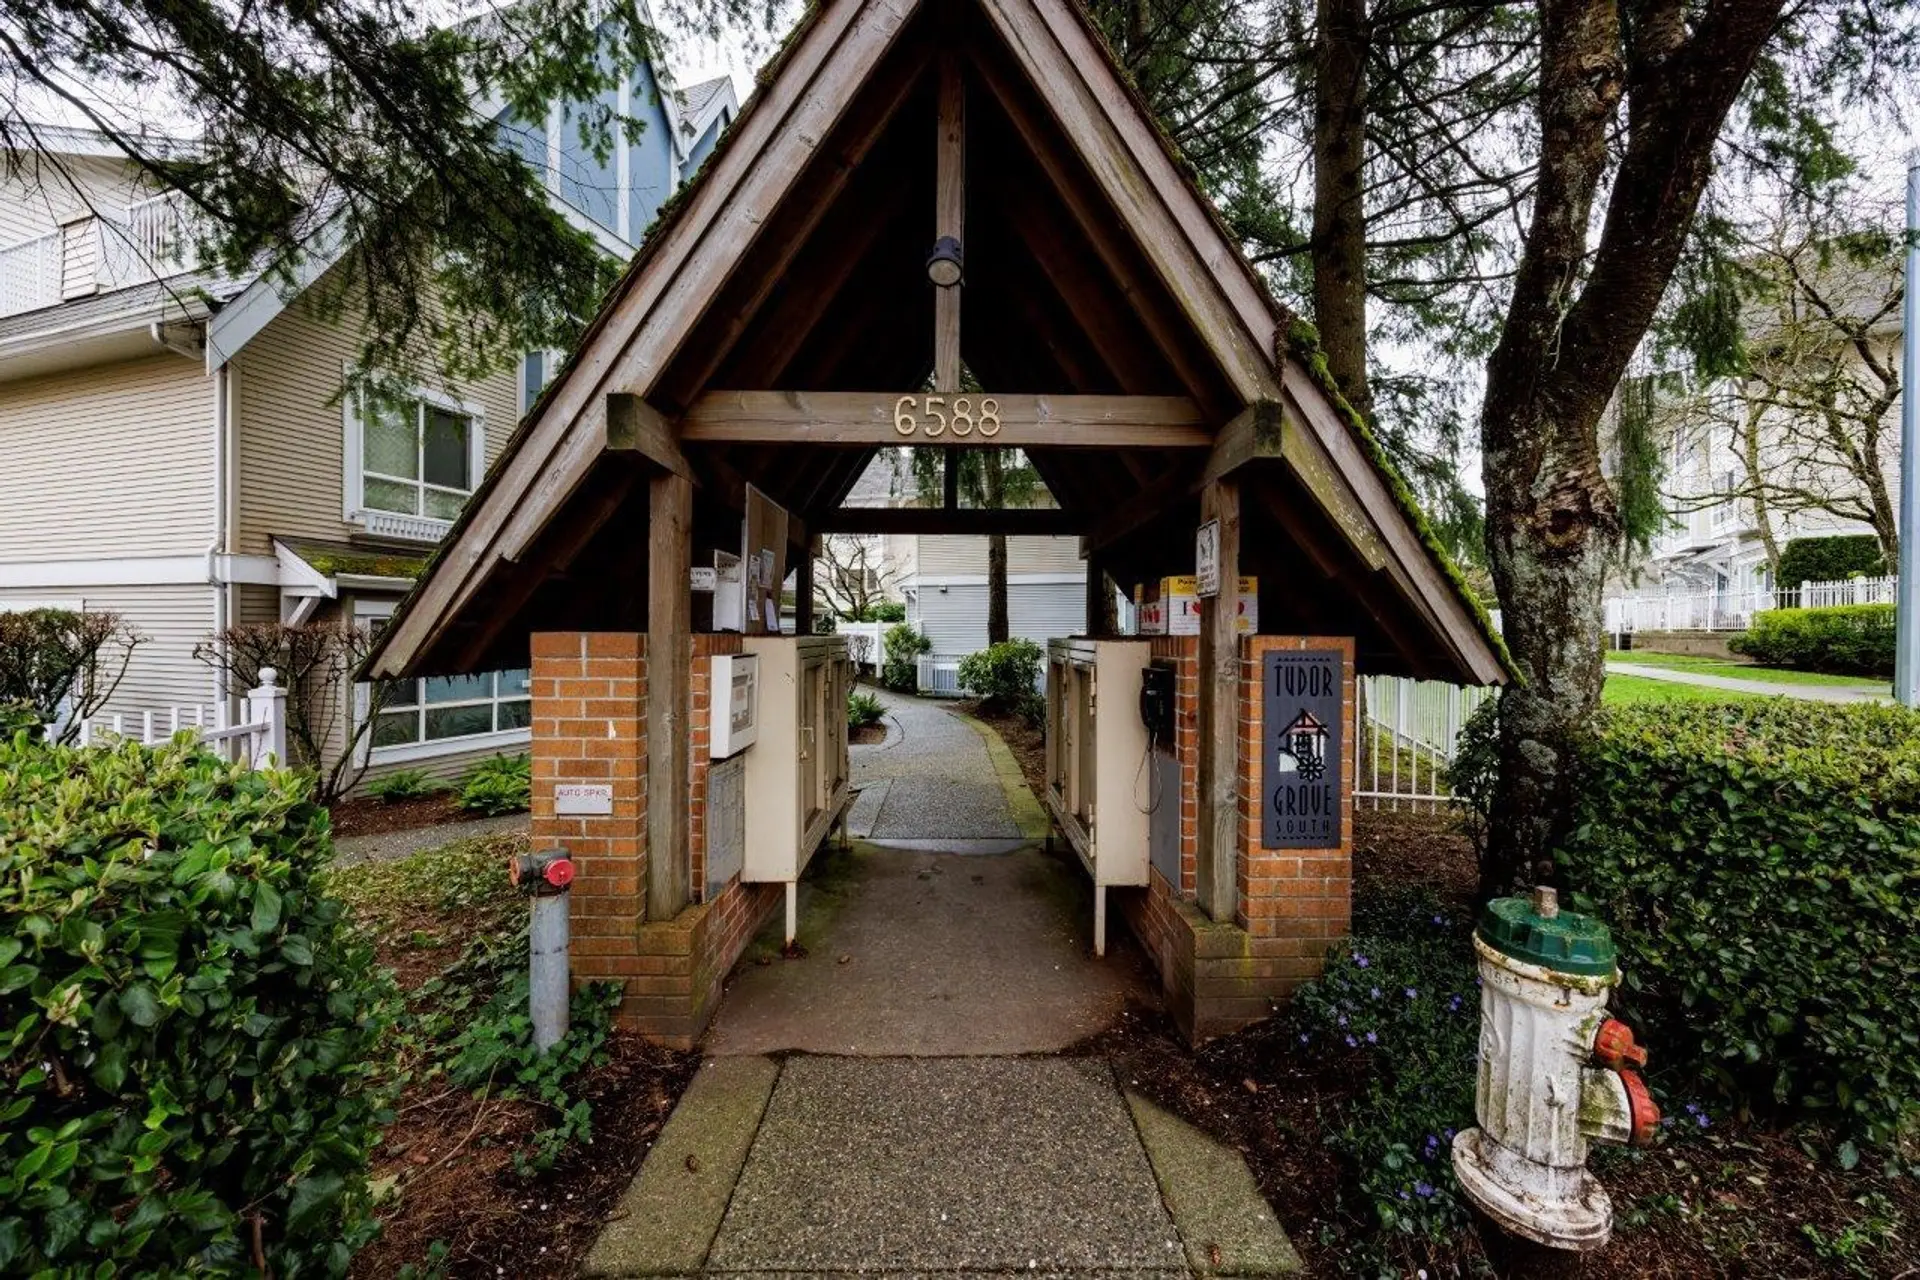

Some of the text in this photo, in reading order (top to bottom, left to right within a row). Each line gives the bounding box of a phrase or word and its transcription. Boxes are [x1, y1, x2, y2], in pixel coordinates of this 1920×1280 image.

[894, 395, 1001, 437] 6588
[1273, 664, 1334, 698] TUDOR
[558, 788, 581, 797] AUTO
[1273, 784, 1332, 817] GROVE
[1275, 819, 1330, 835] SOUTH
